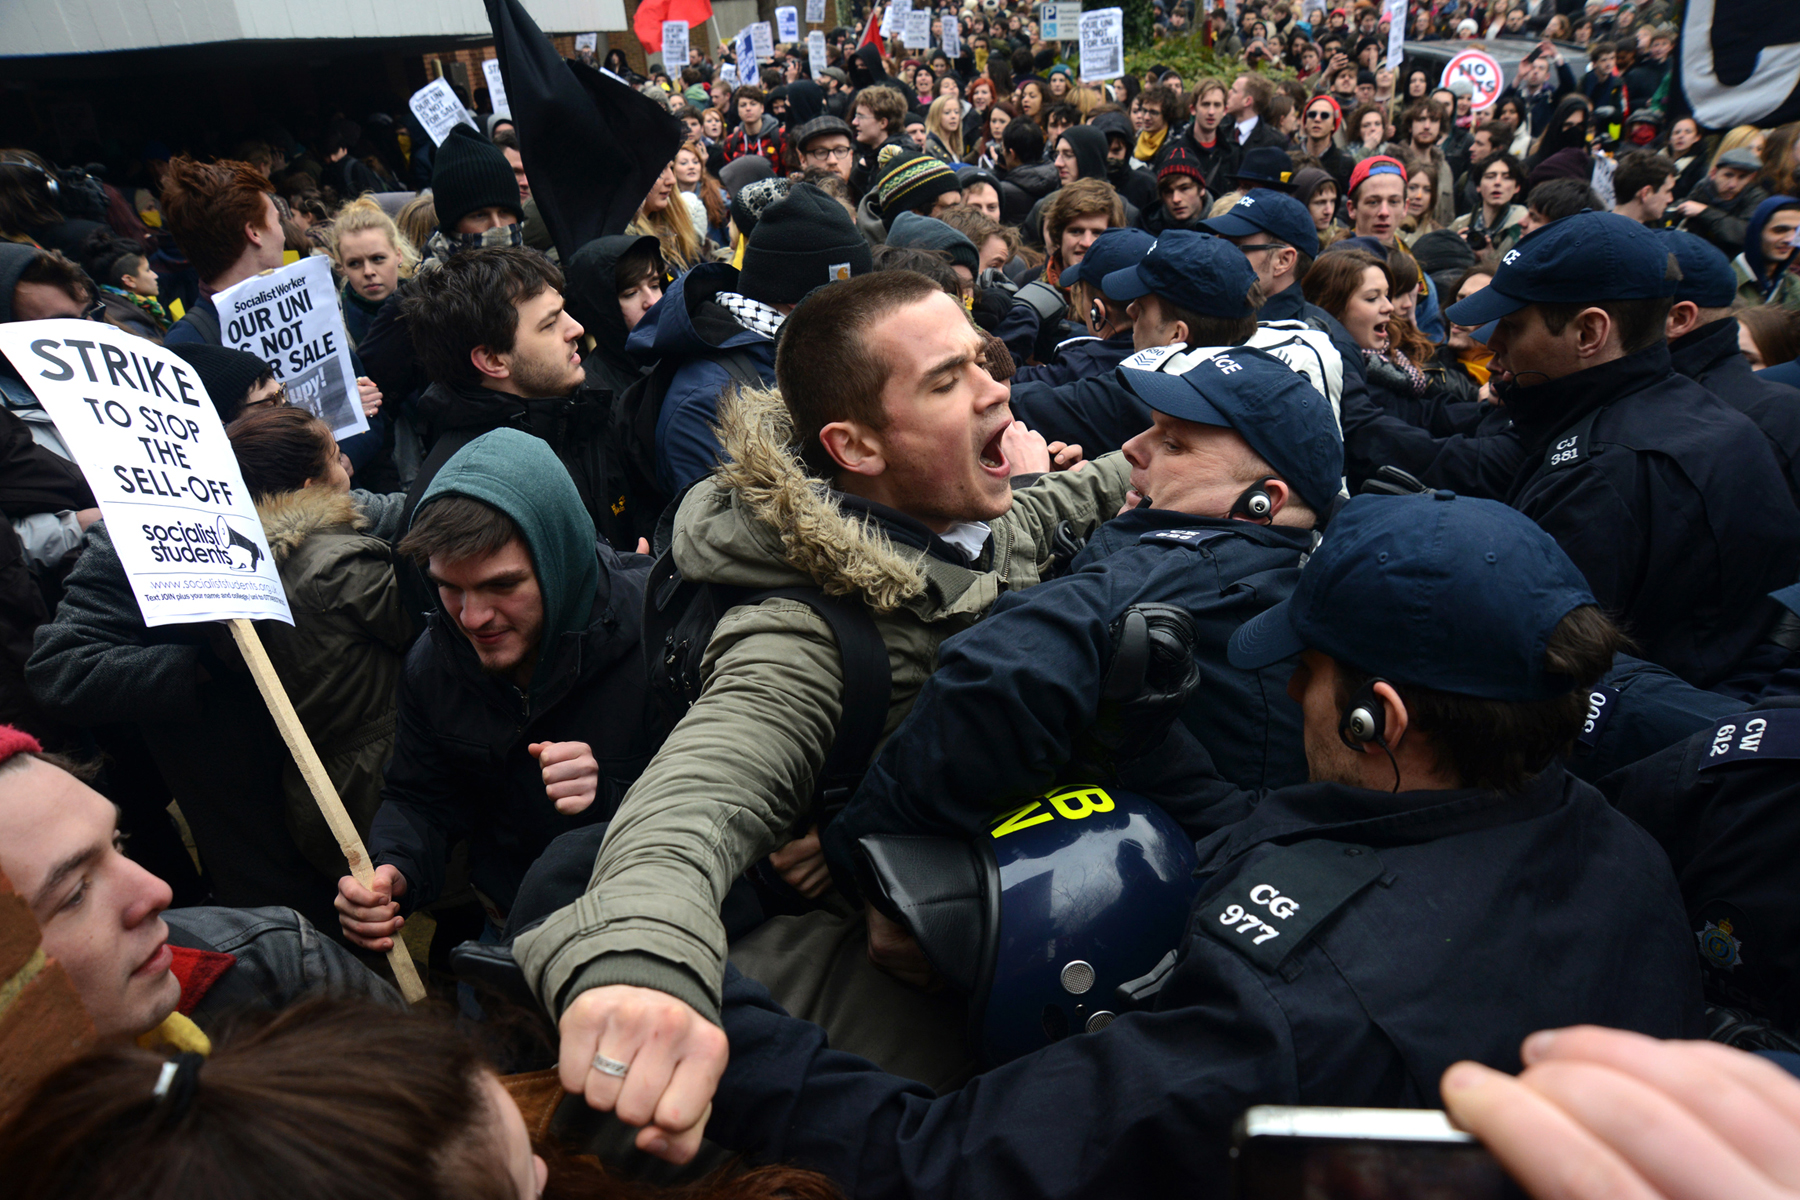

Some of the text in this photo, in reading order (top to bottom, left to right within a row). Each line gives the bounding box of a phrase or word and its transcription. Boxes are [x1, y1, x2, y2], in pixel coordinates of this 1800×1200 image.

[1082, 18, 1113, 29] OUR UNI
[1082, 28, 1107, 39] IS NOT
[1083, 35, 1118, 48] FOR SALE
[1459, 63, 1487, 76] NO
[414, 97, 430, 112] OUR
[430, 90, 445, 104] UNI
[420, 100, 444, 120] IS NOT
[425, 113, 440, 127] FOR
[440, 101, 460, 117] SALE
[227, 288, 314, 344] OUR UNI
[260, 320, 304, 359] NOT
[289, 331, 337, 373] SALE
[30, 338, 200, 408] STRIKE
[1211, 354, 1244, 375] ICE
[83, 397, 200, 443] TO STOP
[137, 436, 192, 470] THE
[1556, 435, 1579, 450] CJ
[1551, 447, 1579, 466] 381
[113, 465, 233, 506] SELL-OFF
[142, 520, 221, 545] socialist
[150, 540, 234, 566] students
[144, 593, 161, 602] Text
[161, 593, 176, 601] JOIN
[176, 592, 191, 602] plus
[191, 592, 203, 601] your
[1709, 724, 1737, 757] 612
[1739, 718, 1767, 752] CW
[1249, 884, 1300, 920] CG
[1219, 904, 1280, 946] 977
